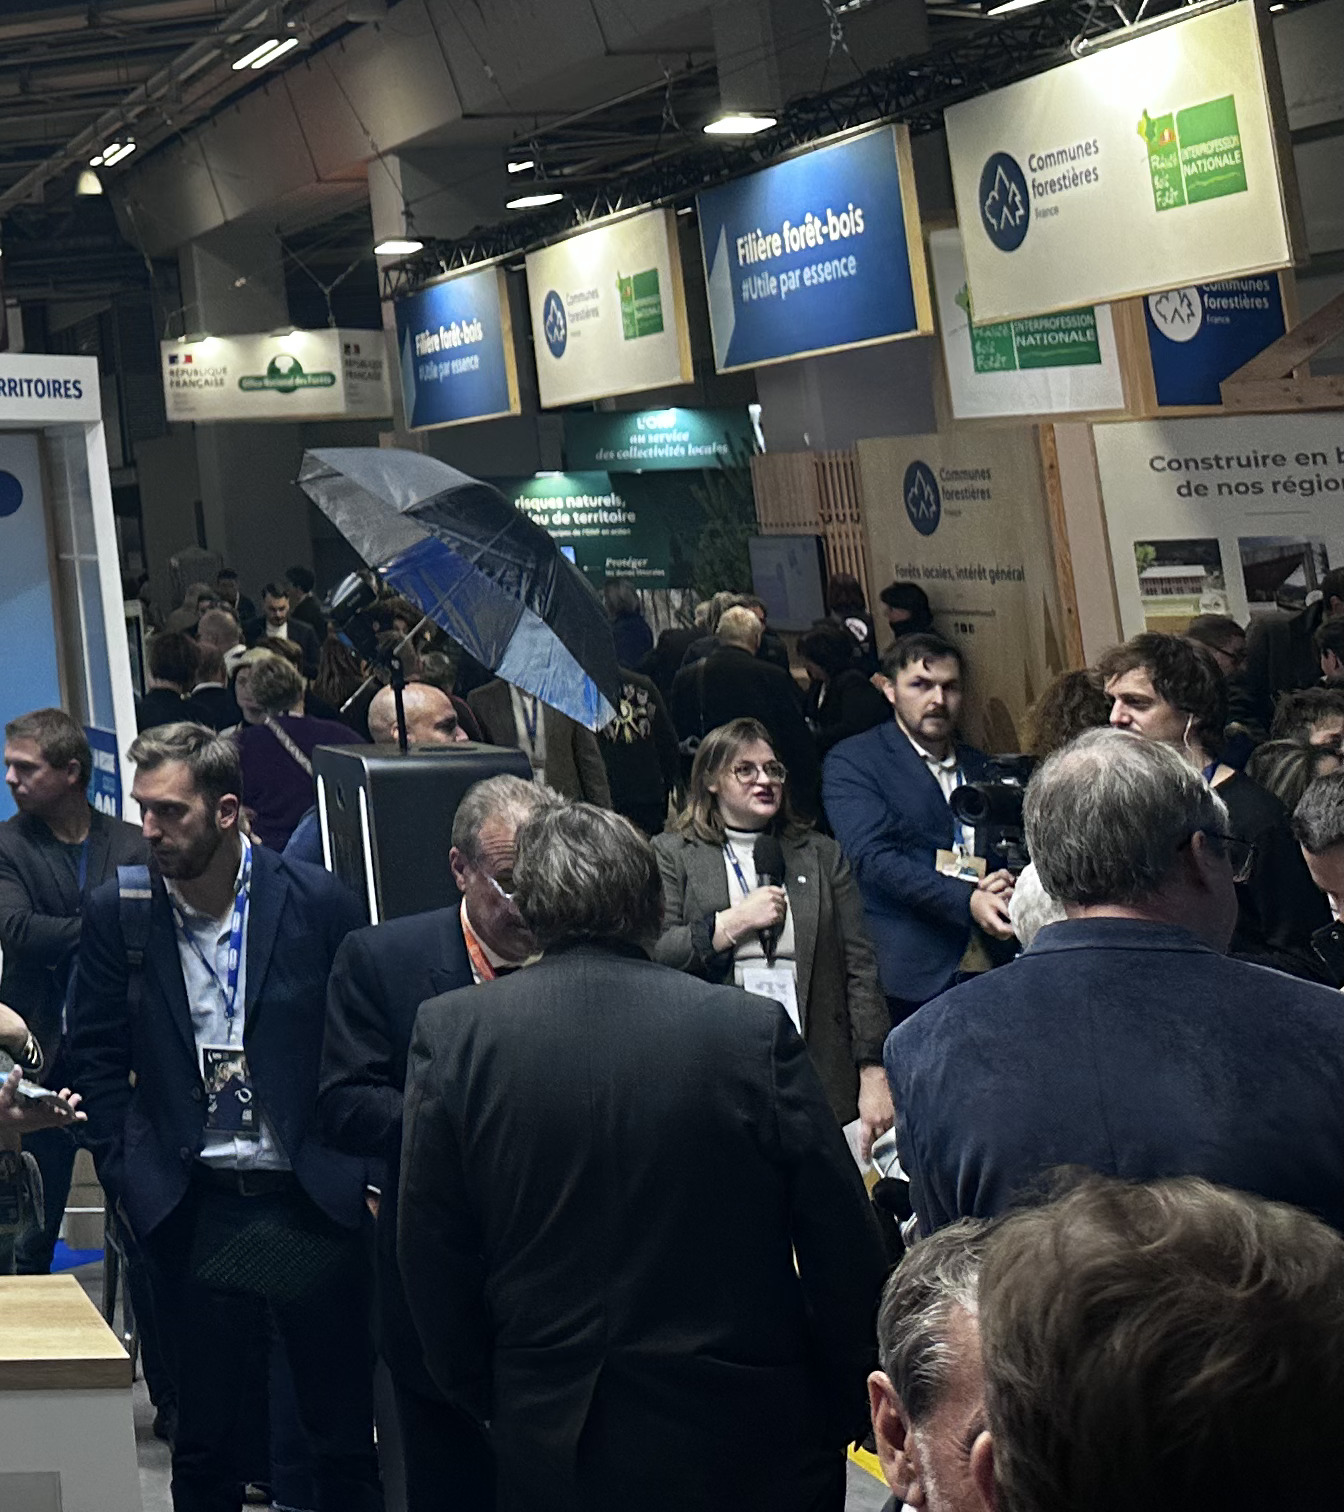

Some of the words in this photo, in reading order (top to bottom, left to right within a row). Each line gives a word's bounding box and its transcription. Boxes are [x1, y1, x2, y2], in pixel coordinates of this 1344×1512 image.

[1028, 138, 1100, 174] Communes
[1183, 149, 1243, 177] NATIONALE
[1031, 165, 1100, 199] forestières
[736, 227, 782, 267] Filière
[783, 202, 865, 254] forêt-bois
[779, 268, 802, 300] par
[803, 254, 857, 287] essence
[1203, 295, 1270, 311] forestières
[1014, 329, 1096, 348] NATIONALE
[595, 448, 615, 461] des
[616, 444, 686, 461] collectivités
[1148, 449, 1288, 473] Construire
[1295, 451, 1328, 467] en
[939, 466, 992, 483] Communes
[941, 486, 992, 502] forestières
[1176, 480, 1210, 499] de
[1217, 480, 1265, 497] nos
[515, 493, 565, 513] risques
[550, 509, 571, 526] de
[572, 508, 637, 525] territoire
[988, 564, 1026, 586] général
